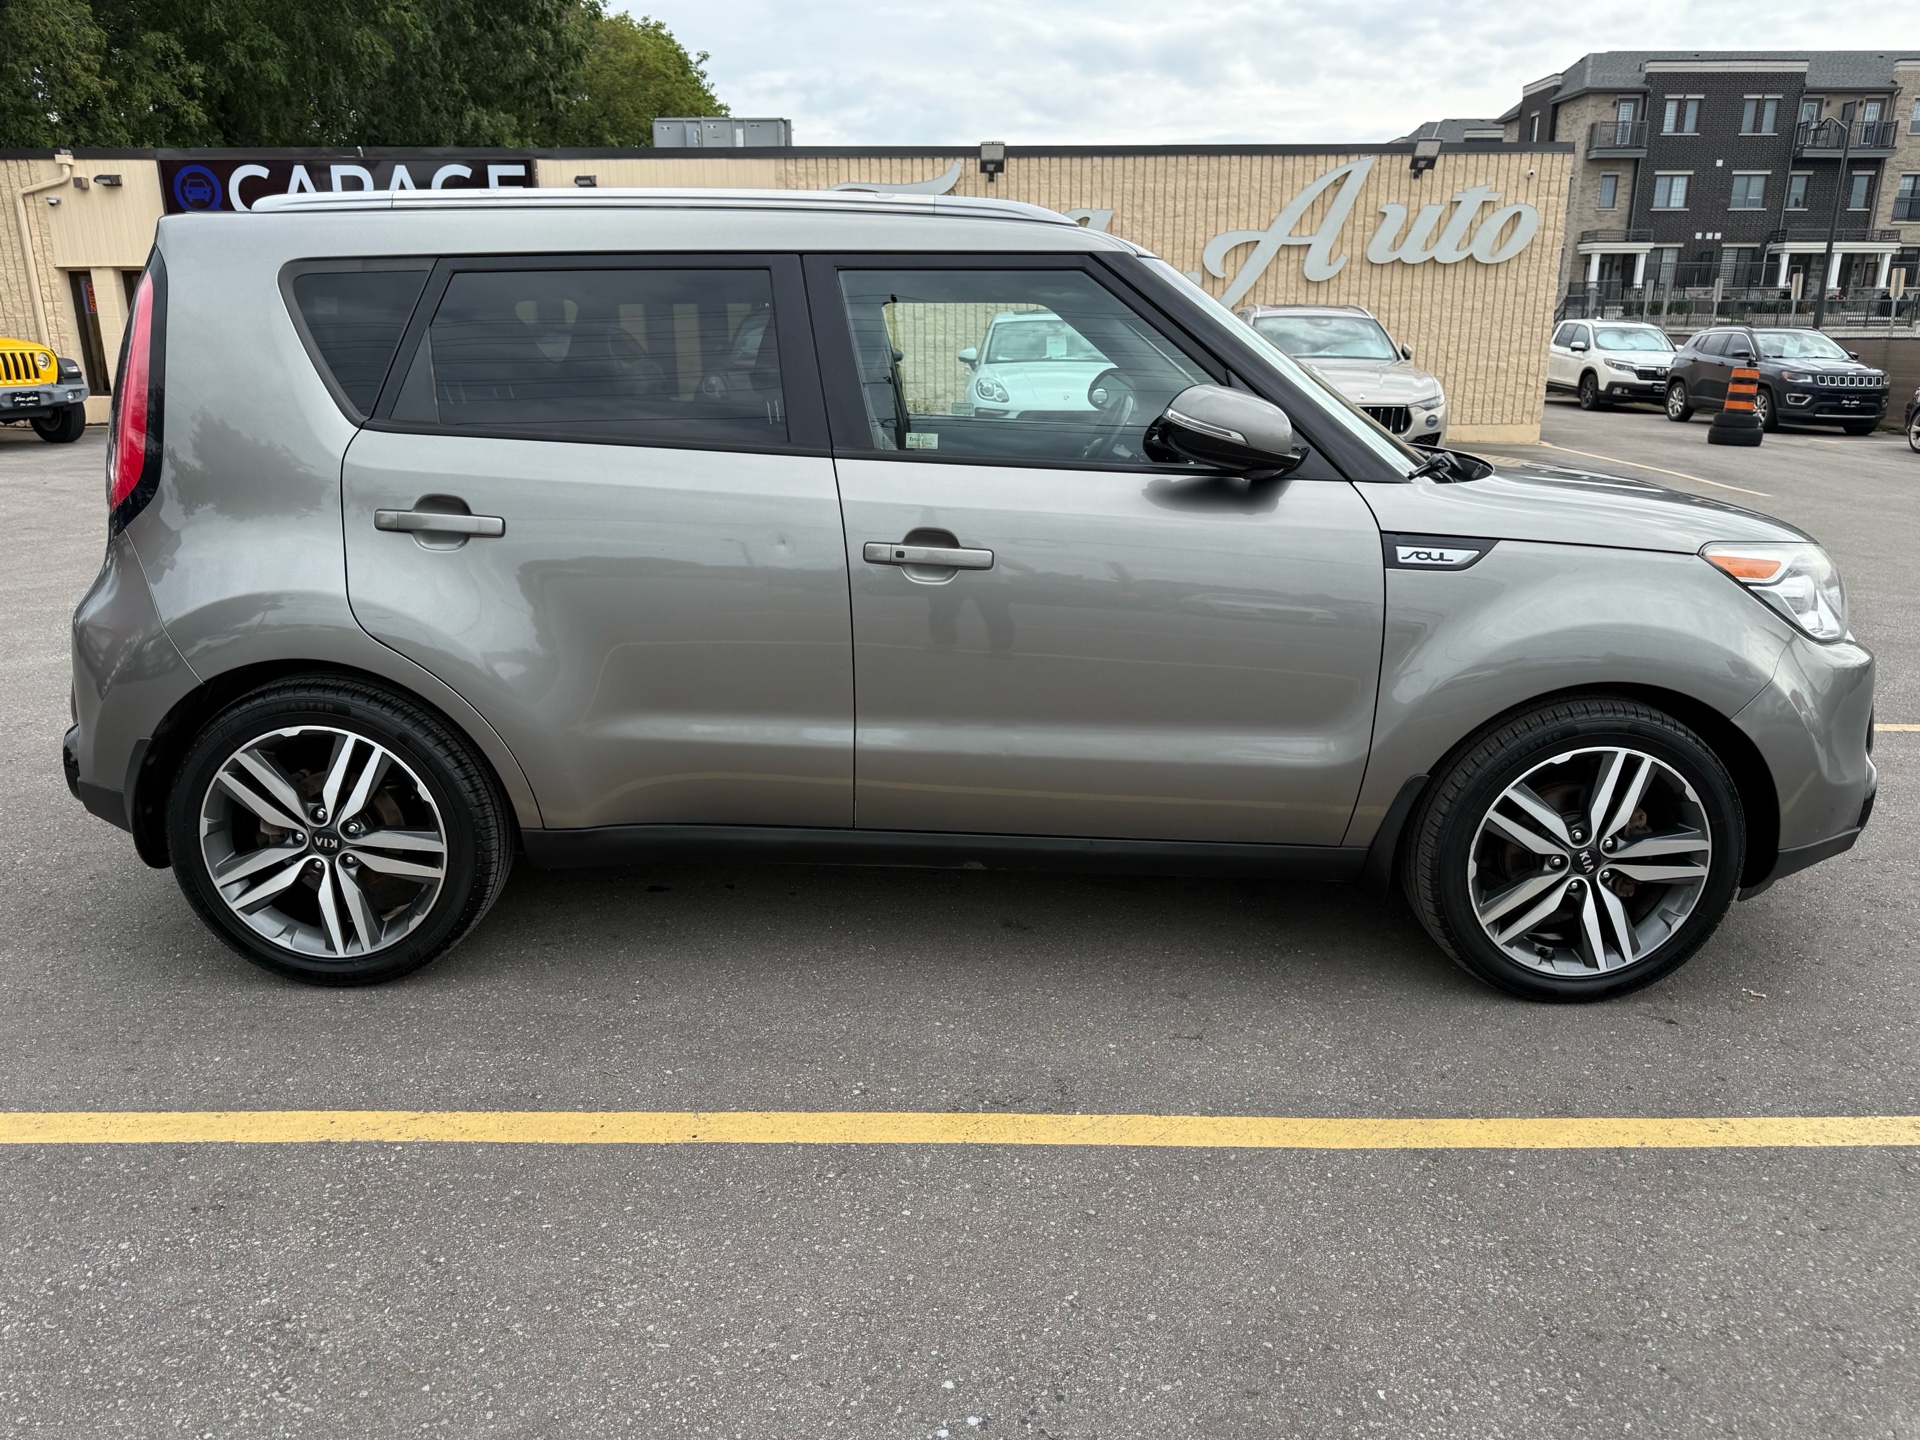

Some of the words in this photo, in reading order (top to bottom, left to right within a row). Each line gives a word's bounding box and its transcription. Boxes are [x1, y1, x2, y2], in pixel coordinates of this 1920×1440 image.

[1203, 156, 1540, 311] Auto
[1401, 551, 1454, 562] SOUL
[314, 836, 339, 849] KIA
[1579, 850, 1595, 874] KIA
